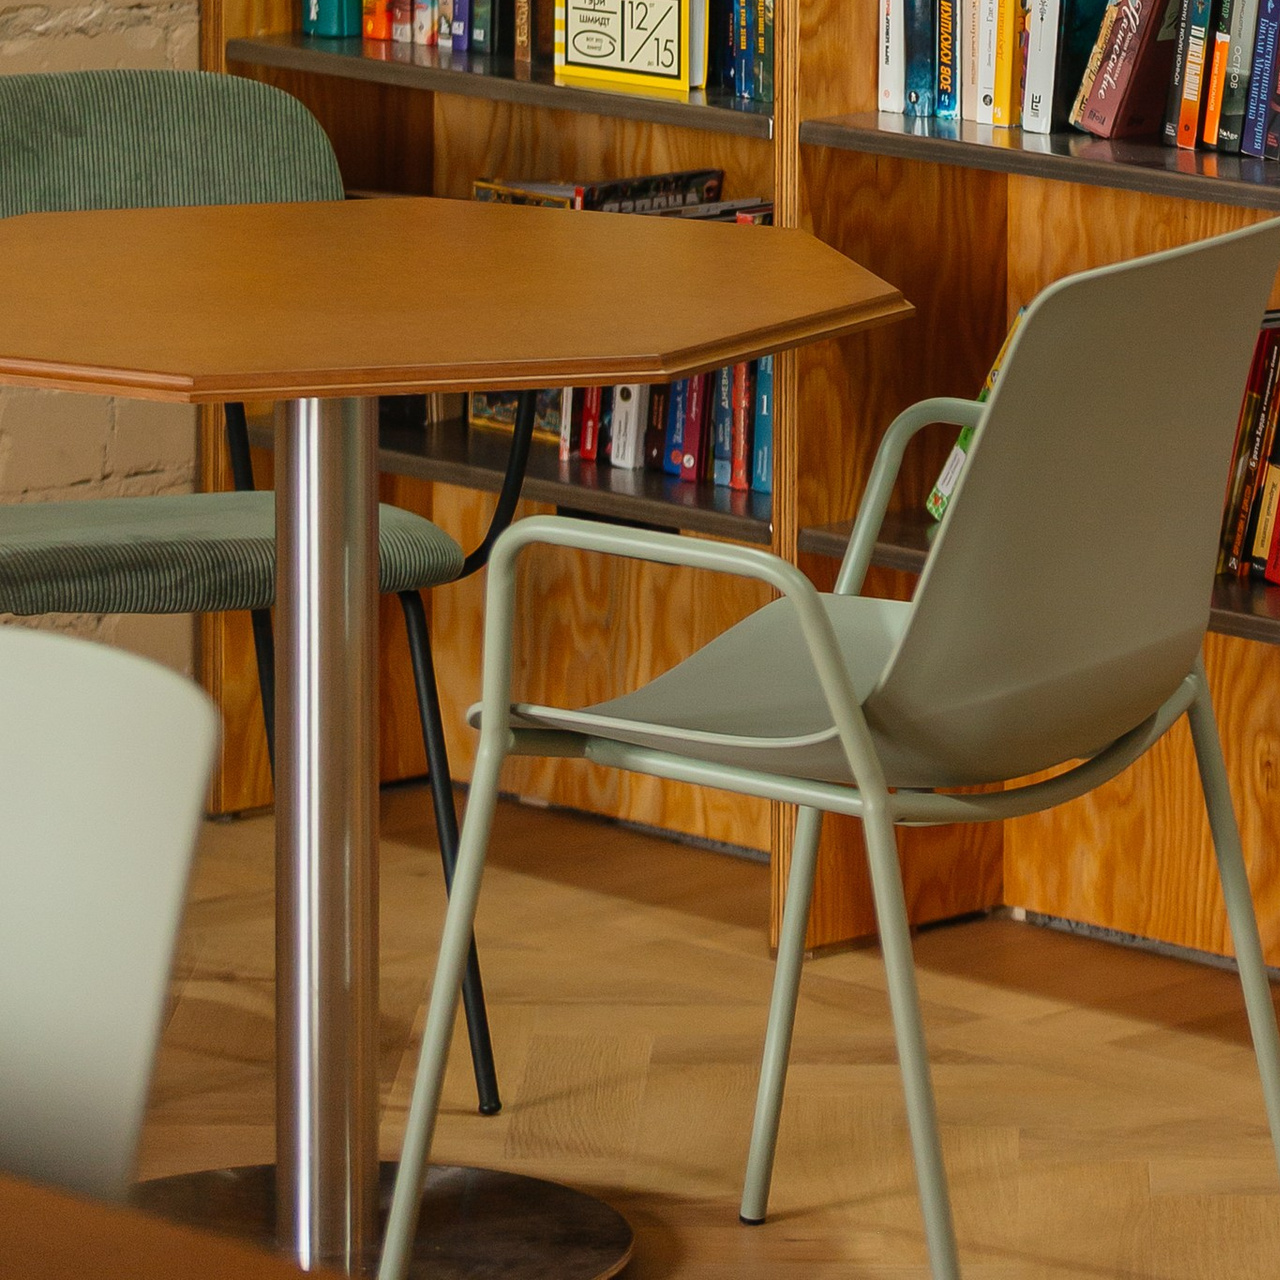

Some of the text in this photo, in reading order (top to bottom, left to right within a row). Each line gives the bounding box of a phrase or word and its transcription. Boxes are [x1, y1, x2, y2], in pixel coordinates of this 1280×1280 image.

[628, 1, 649, 31] 12
[654, 38, 675, 68] 15
[939, 0, 952, 93] ЗОВ КУКУШКИ
